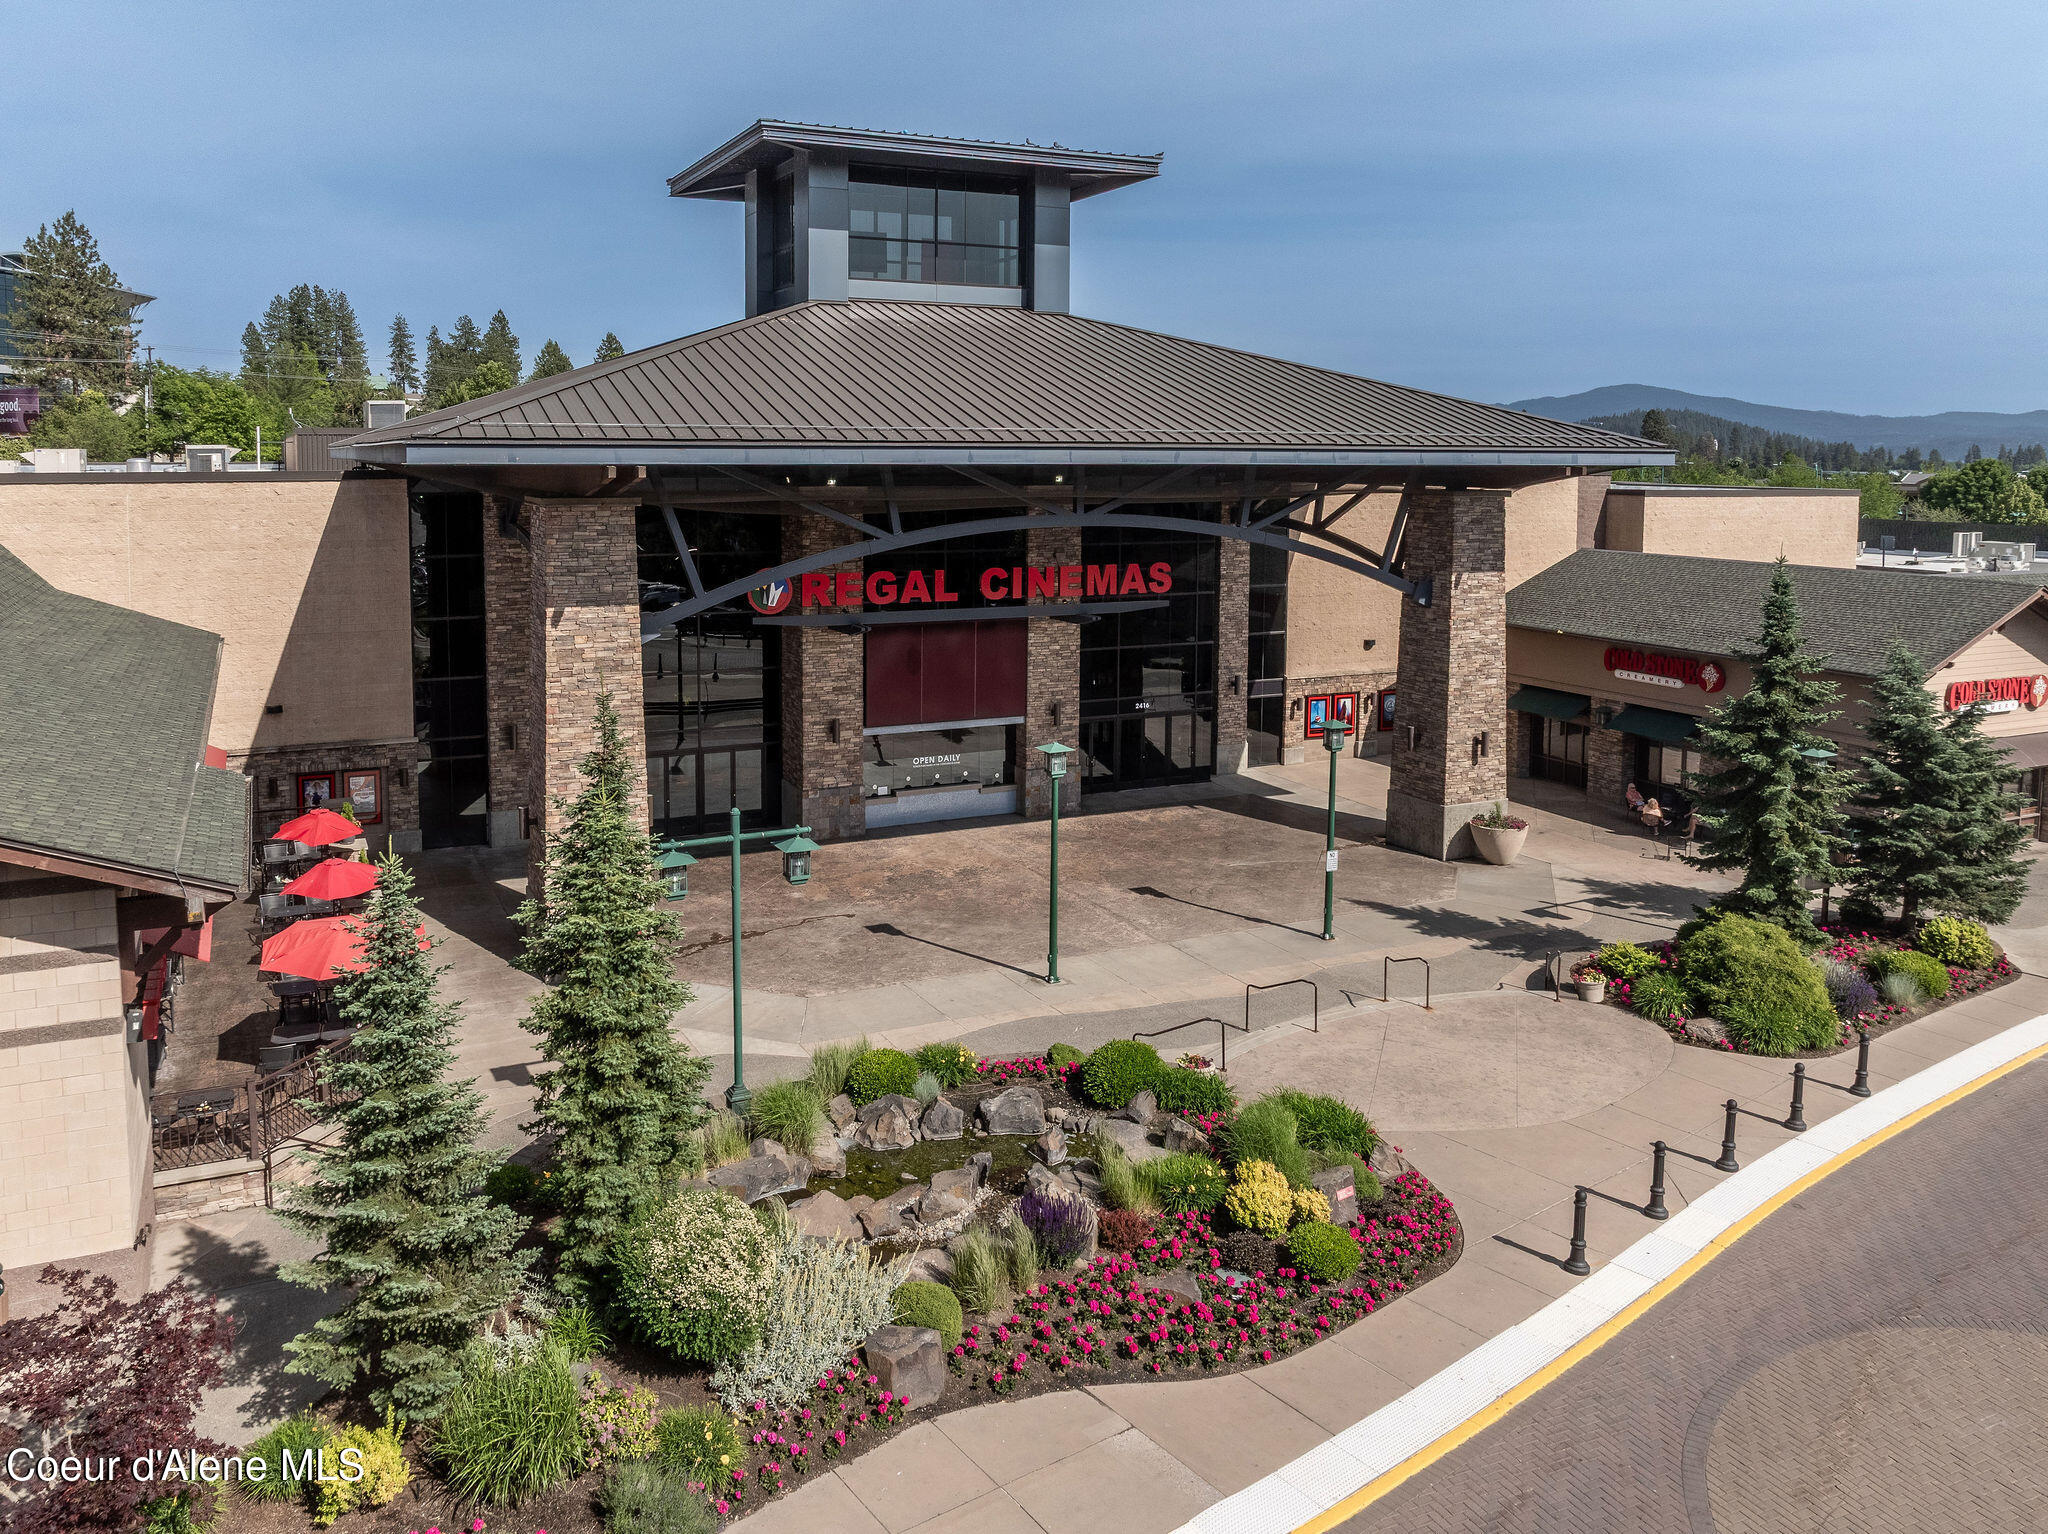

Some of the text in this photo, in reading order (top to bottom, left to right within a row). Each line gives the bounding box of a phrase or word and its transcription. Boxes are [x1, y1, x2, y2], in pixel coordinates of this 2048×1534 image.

[801, 562, 1172, 607] REGAL CINEMAS
[1604, 647, 1698, 684] COLD STONE
[1619, 671, 1677, 686] CREAMERY
[1950, 676, 2031, 710] COLD STONE
[912, 757, 935, 765] OPEN
[938, 753, 961, 763] DAILY
